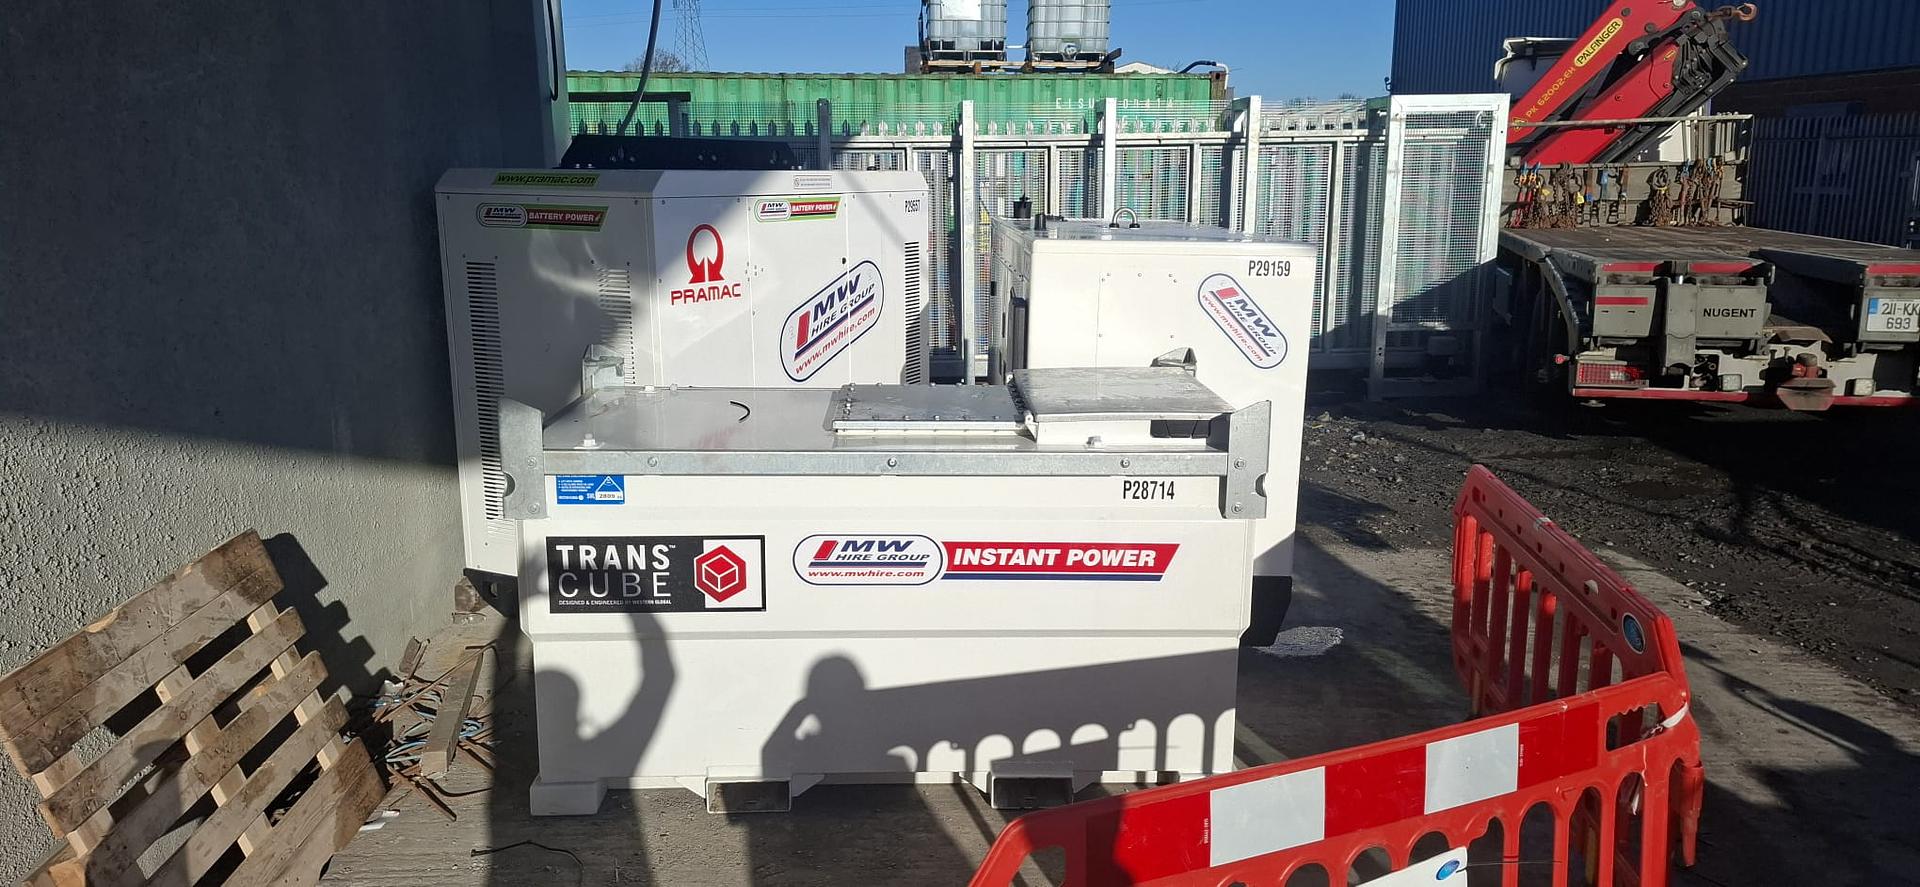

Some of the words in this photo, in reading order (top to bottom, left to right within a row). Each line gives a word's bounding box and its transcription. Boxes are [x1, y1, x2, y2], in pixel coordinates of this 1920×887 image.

[1576, 21, 1621, 65] PALFINGER
[1526, 105, 1539, 118] PK
[497, 174, 597, 185] www.pramac.com
[528, 212, 563, 221] BATTERY
[565, 213, 595, 222] POWER
[792, 204, 815, 212] BATTERY
[815, 203, 833, 211] POWER
[1248, 260, 1291, 277] P29159
[671, 283, 741, 306] PRAMAC
[813, 273, 861, 323] MW
[811, 310, 837, 337] HIRE
[840, 283, 875, 314] GROUP
[1234, 298, 1278, 338] MW
[1703, 308, 1757, 318] NUGENT
[1202, 294, 1264, 362] www.mwhire.com
[1226, 301, 1248, 323] HIRE
[1247, 324, 1277, 355] GROUP
[1886, 317, 1911, 330] 693
[795, 307, 875, 374] www.mwhire.com
[1122, 480, 1175, 500] P28714
[841, 540, 915, 552] MW
[556, 544, 670, 570] TRANS
[953, 548, 1062, 566] INSTANT
[1066, 549, 1157, 567] POWER
[808, 569, 925, 578] www.mwhire.com
[558, 572, 671, 597] CUBE
